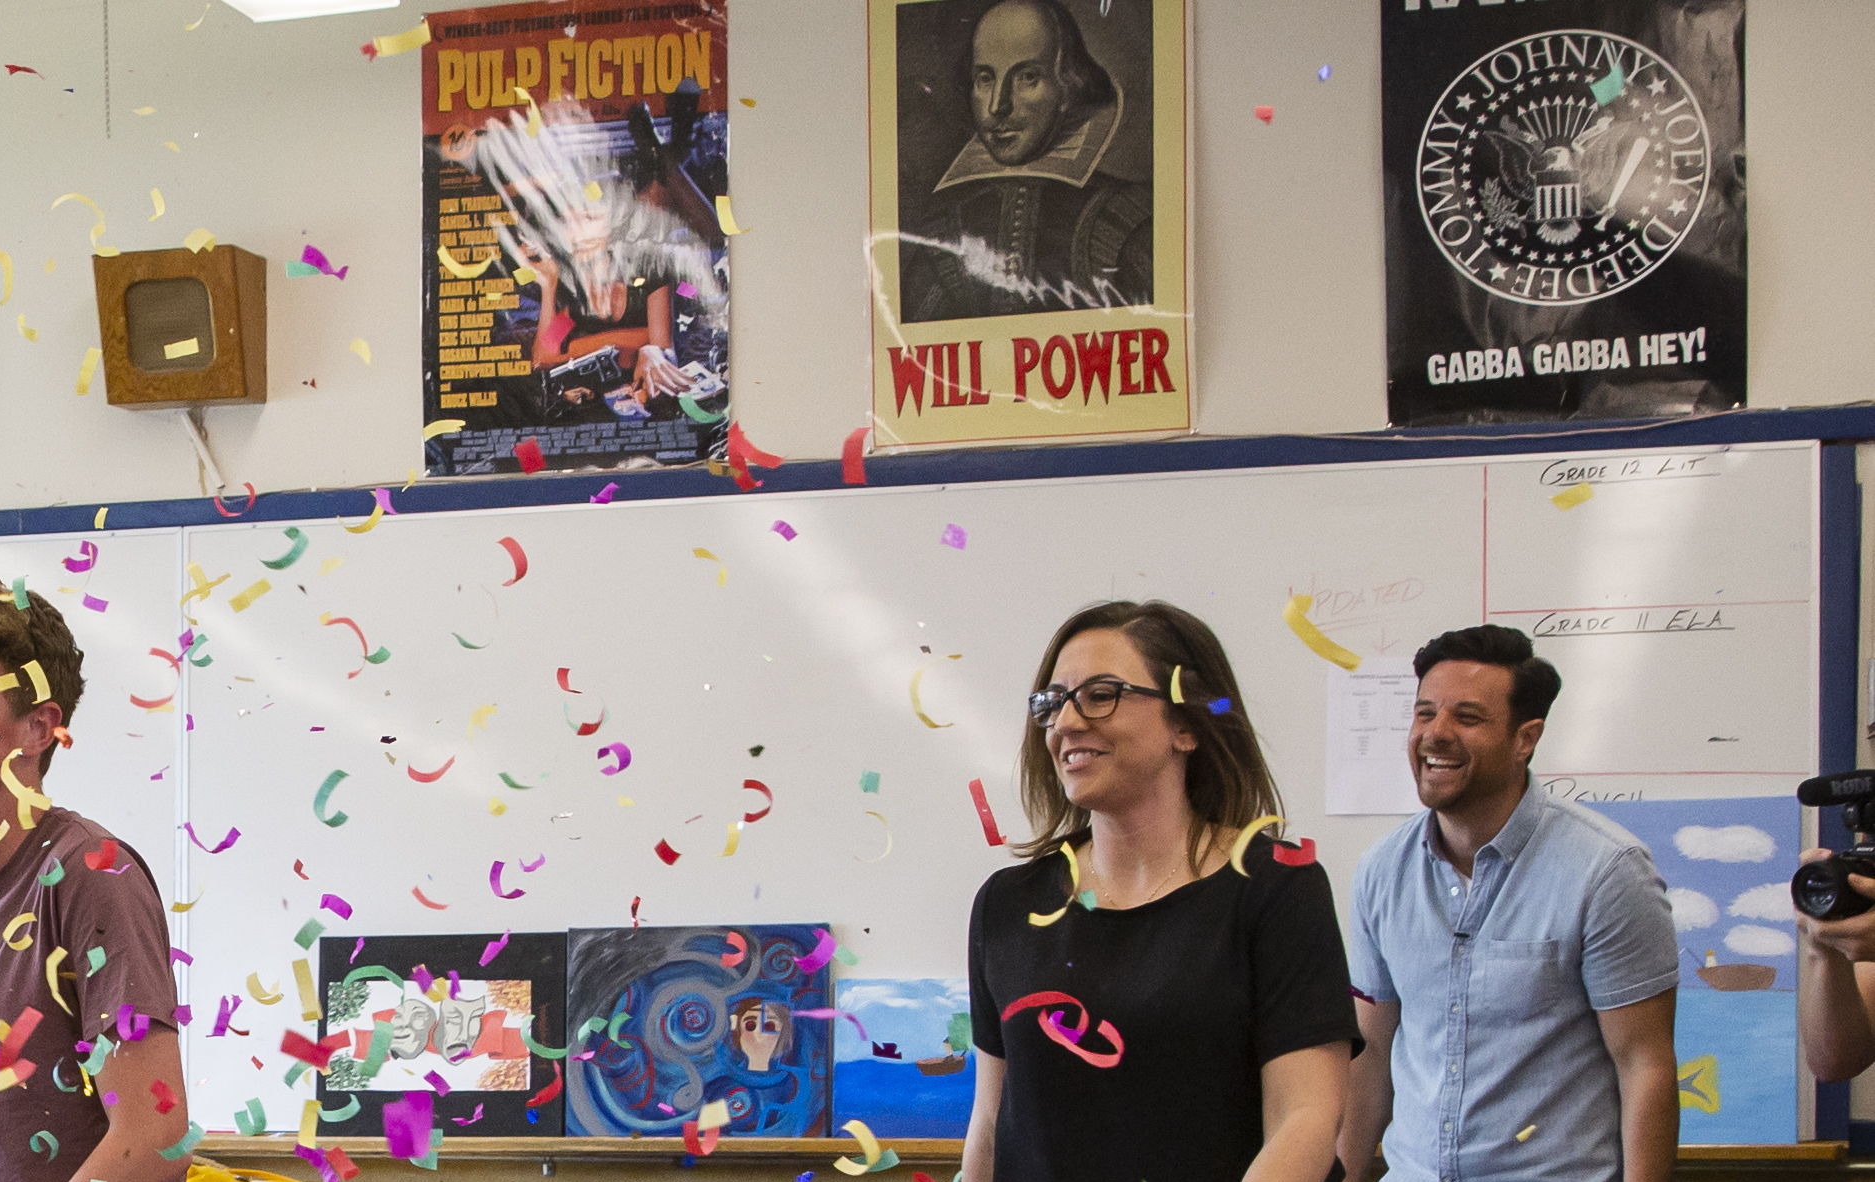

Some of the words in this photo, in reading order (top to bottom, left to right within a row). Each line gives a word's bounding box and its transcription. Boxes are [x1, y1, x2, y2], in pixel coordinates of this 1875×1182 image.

[437, 46, 543, 113] PULP
[547, 30, 712, 102] FICTION
[1469, 34, 1659, 99] JOHNNY
[1654, 96, 1705, 198] JOEY
[1422, 106, 1491, 275] TOMMY
[886, 339, 992, 419] WILL
[1011, 327, 1177, 407] POWER
[1427, 346, 1524, 386] GABBA
[1533, 336, 1631, 376] GABBA
[1638, 326, 1707, 367] HEY!
[1539, 458, 1608, 487] GRADE
[1620, 459, 1642, 477] 12
[1656, 456, 1707, 477] LIT
[1532, 612, 1615, 637] GRADE
[1636, 611, 1650, 630] 11
[1665, 609, 1723, 631] ELA
